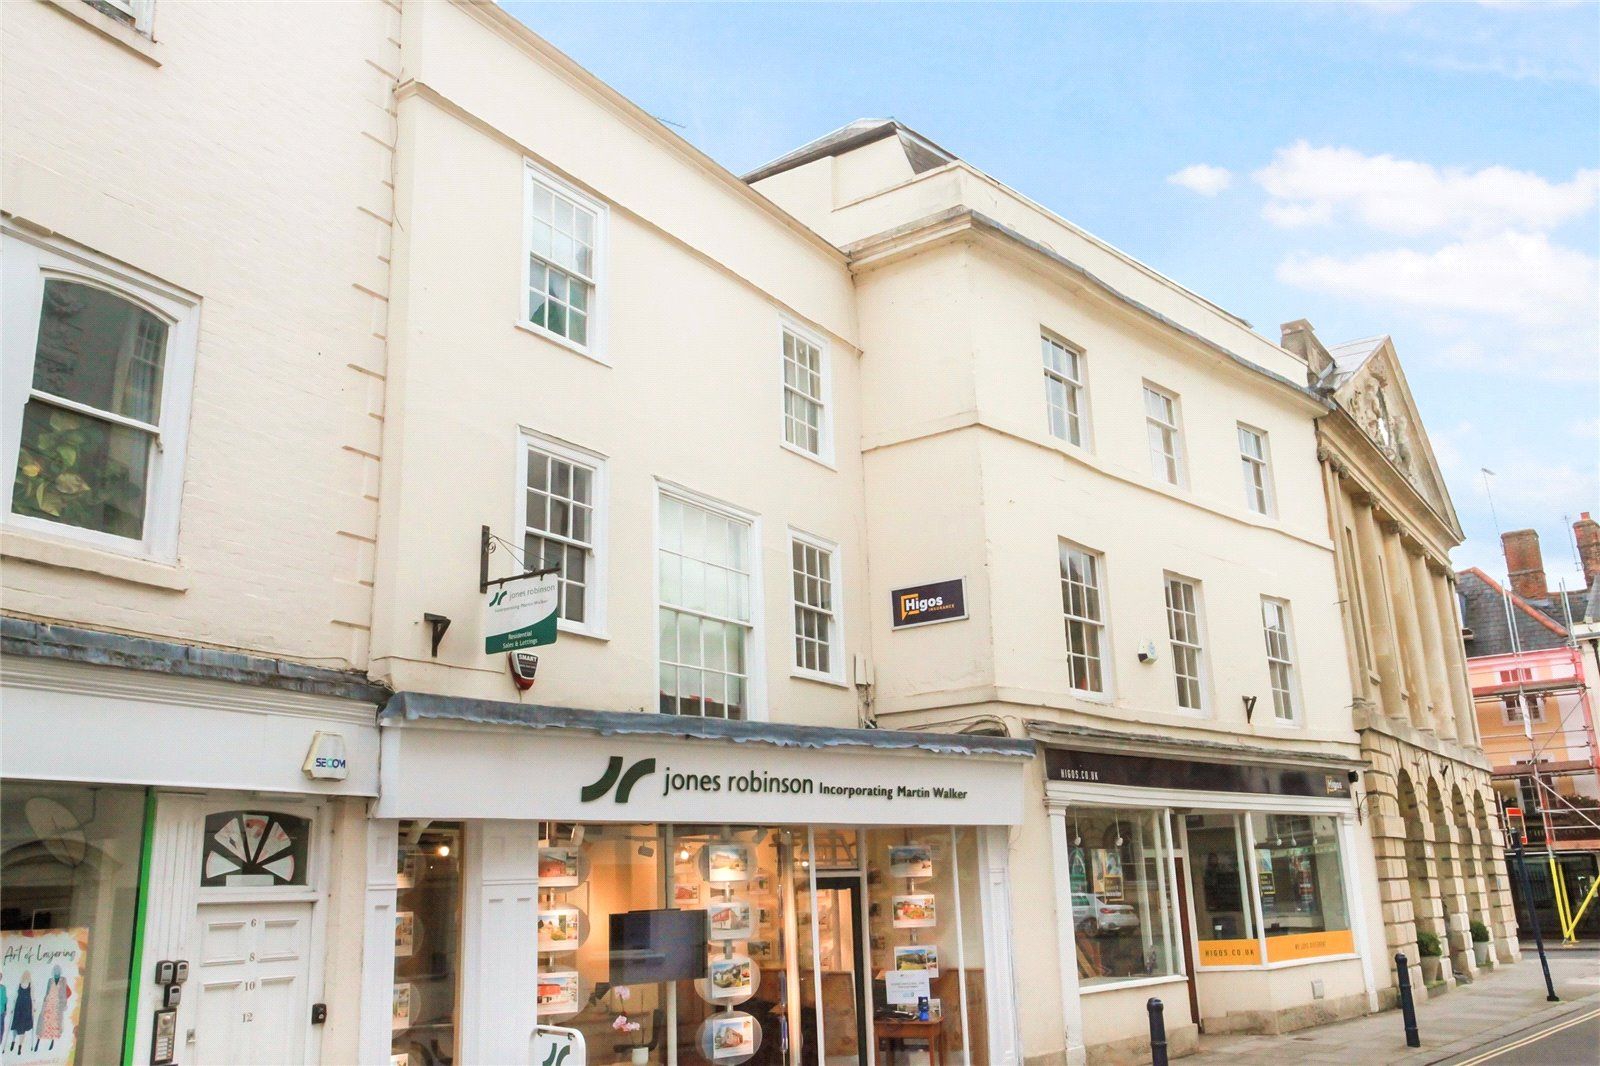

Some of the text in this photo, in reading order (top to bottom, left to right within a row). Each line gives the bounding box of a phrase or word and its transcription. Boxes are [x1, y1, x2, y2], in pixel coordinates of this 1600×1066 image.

[509, 585, 555, 600] jones robinson
[905, 596, 943, 612] Higos
[928, 603, 955, 612] INSURANCE
[508, 631, 533, 640] Residential
[520, 638, 538, 646] Lettings
[315, 757, 346, 769] SECOM
[1060, 768, 1099, 781] HIGOS.CO.UK
[663, 767, 968, 800] jones robinson Incorporating Martin Walker
[250, 918, 257, 928] 6
[3, 945, 23, 966] Art
[36, 943, 76, 965] Layering
[249, 952, 256, 962] 8
[244, 981, 255, 991] 10
[242, 1012, 253, 1023] 12
